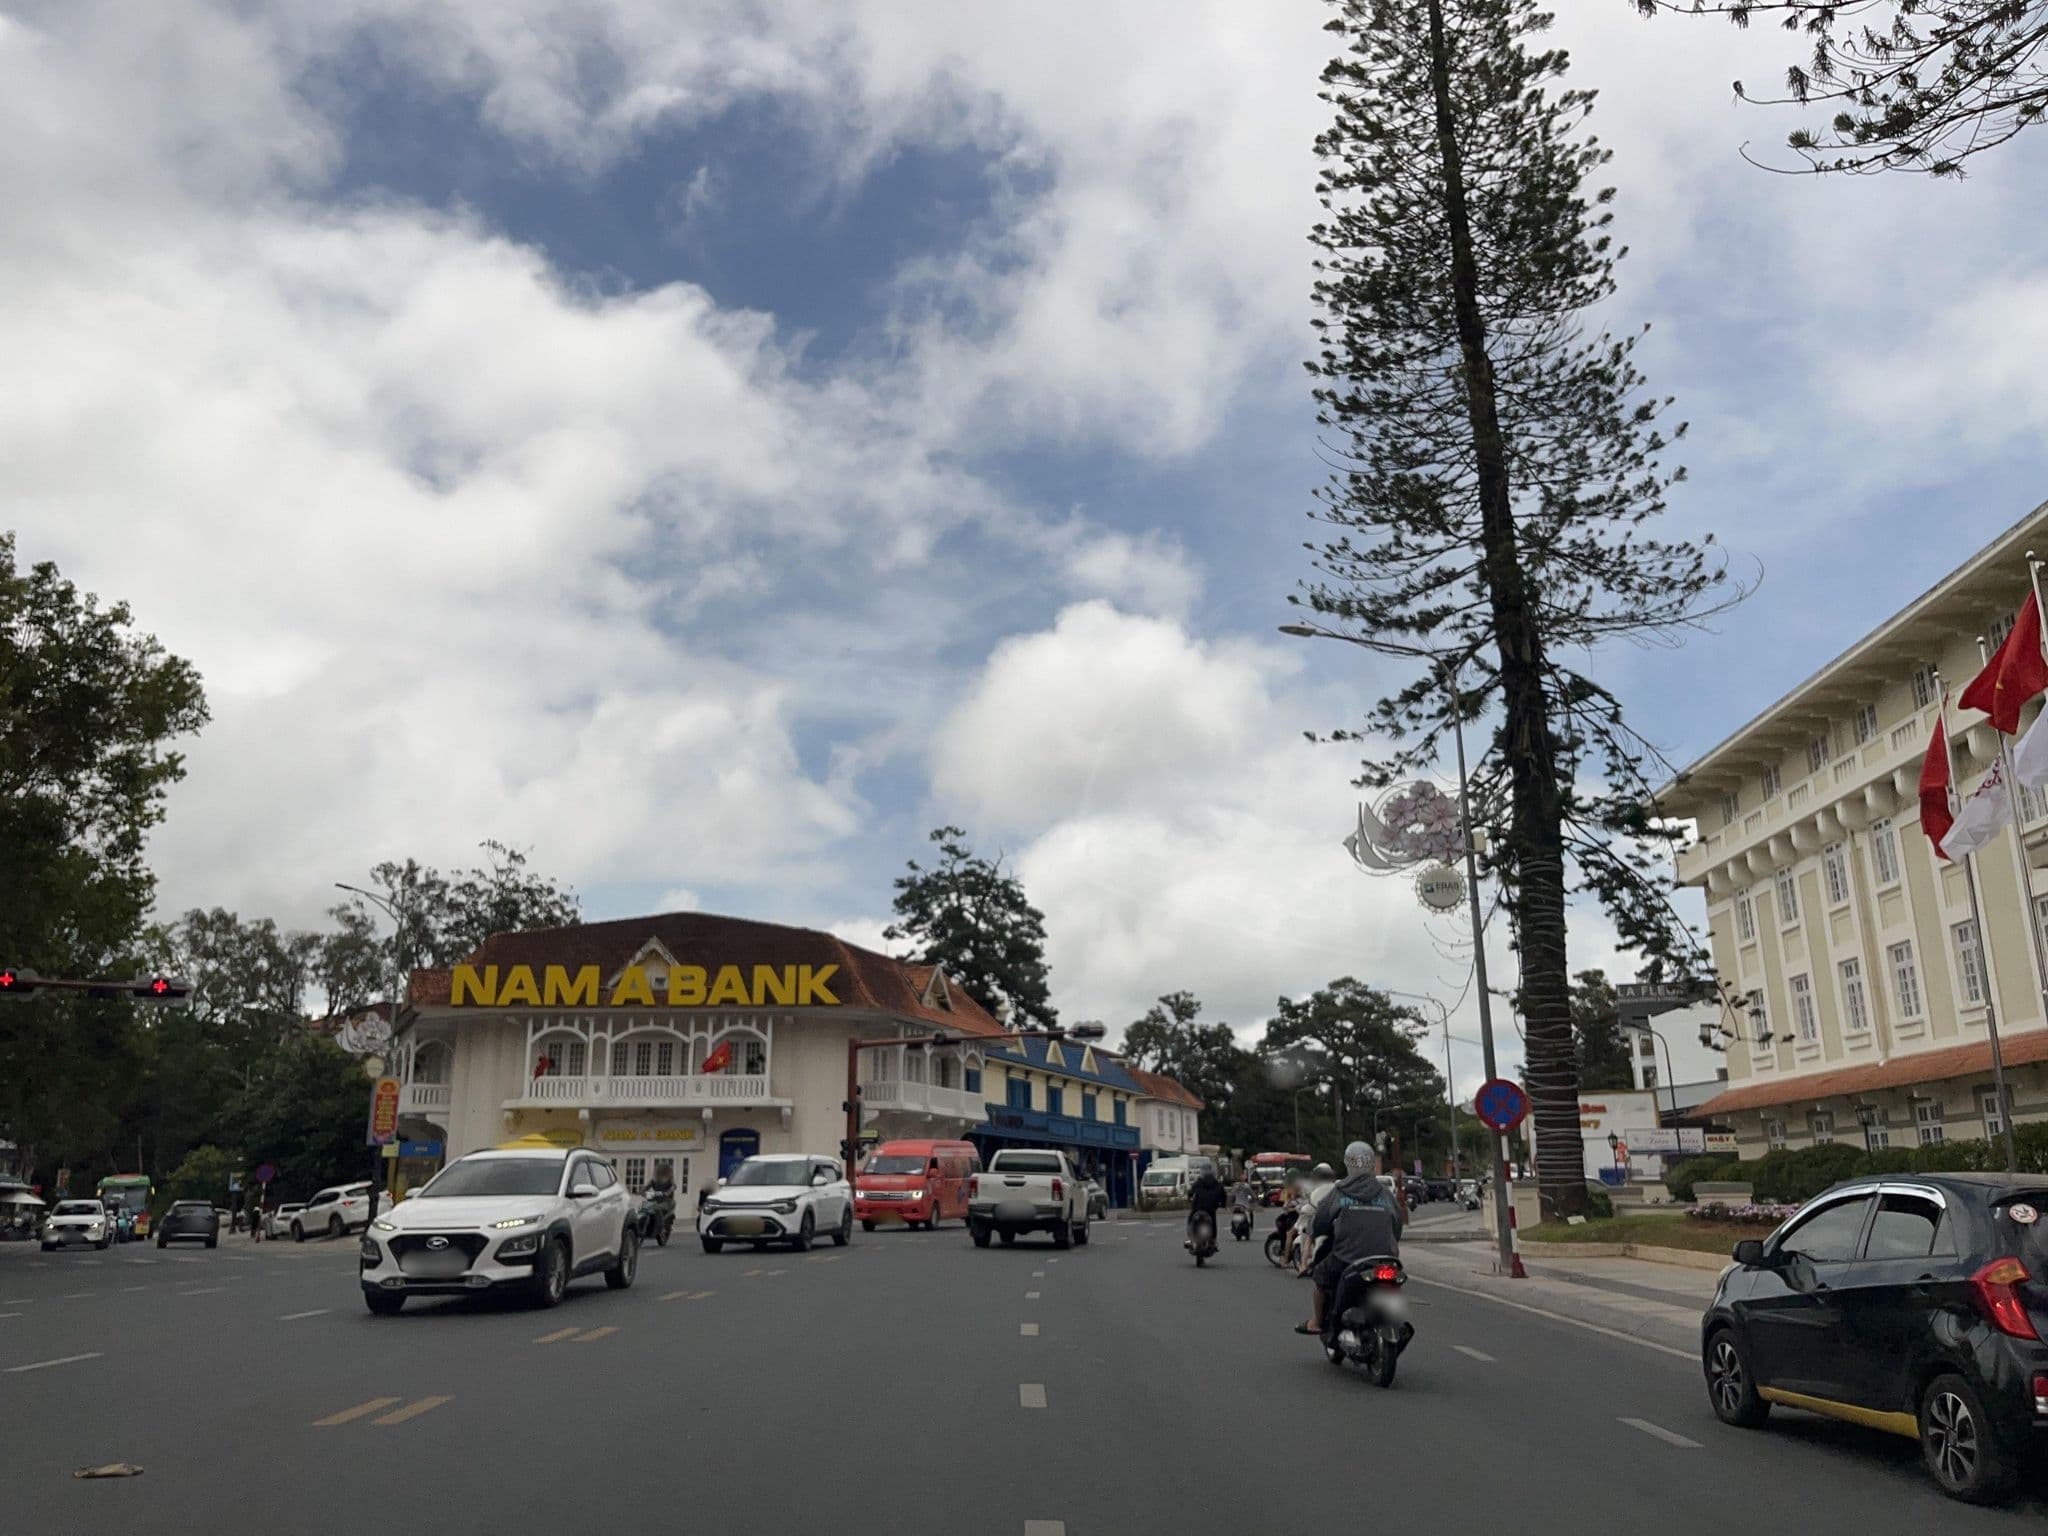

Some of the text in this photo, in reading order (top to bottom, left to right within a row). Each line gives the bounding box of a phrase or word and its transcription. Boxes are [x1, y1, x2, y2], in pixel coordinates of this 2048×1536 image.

[450, 964, 841, 1006] NAM A BANK
